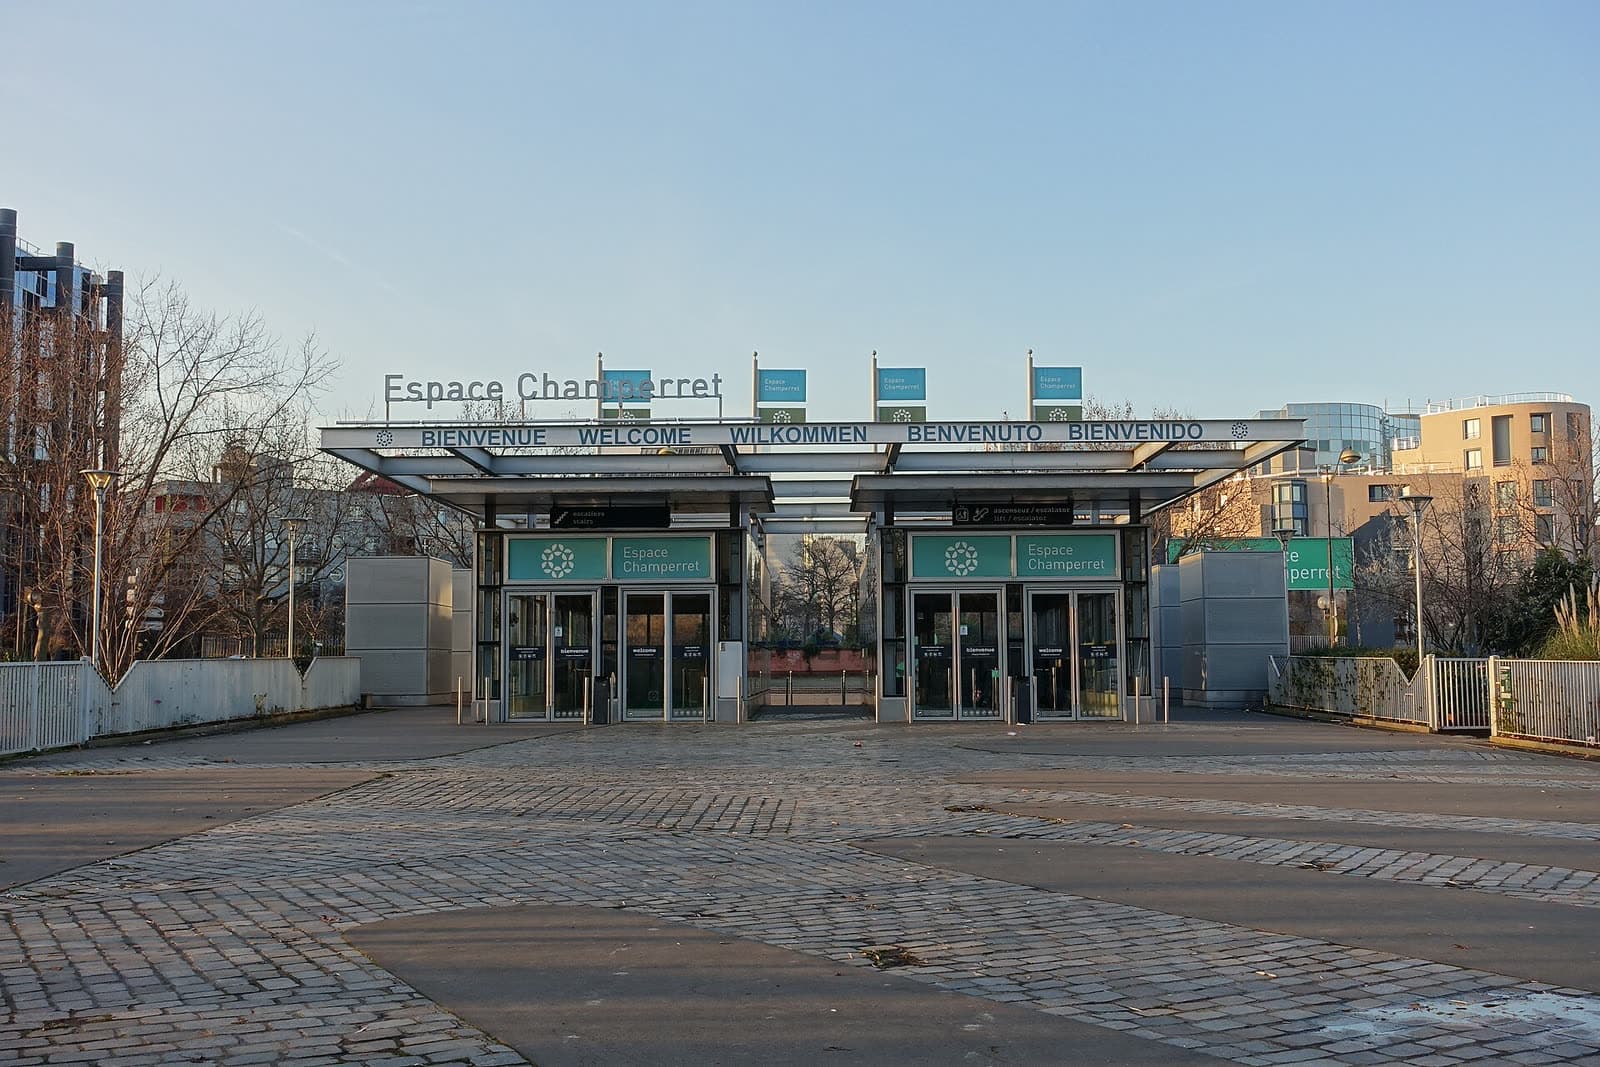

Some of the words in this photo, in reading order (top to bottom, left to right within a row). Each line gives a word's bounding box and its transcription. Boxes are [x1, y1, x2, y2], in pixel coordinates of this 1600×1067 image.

[385, 374, 503, 409] Espace
[519, 372, 722, 406] Champerret
[422, 430, 547, 446] BIENVENUE
[579, 428, 692, 445] WELCOME
[730, 426, 867, 443] WILKOMMEN
[908, 425, 1042, 442] BENVENUTO
[1068, 424, 1203, 441] BIENVENIDO
[623, 546, 668, 560] Espace
[1028, 543, 1073, 558] Espace
[623, 561, 700, 575] Champerret
[1028, 558, 1105, 572] Champerret
